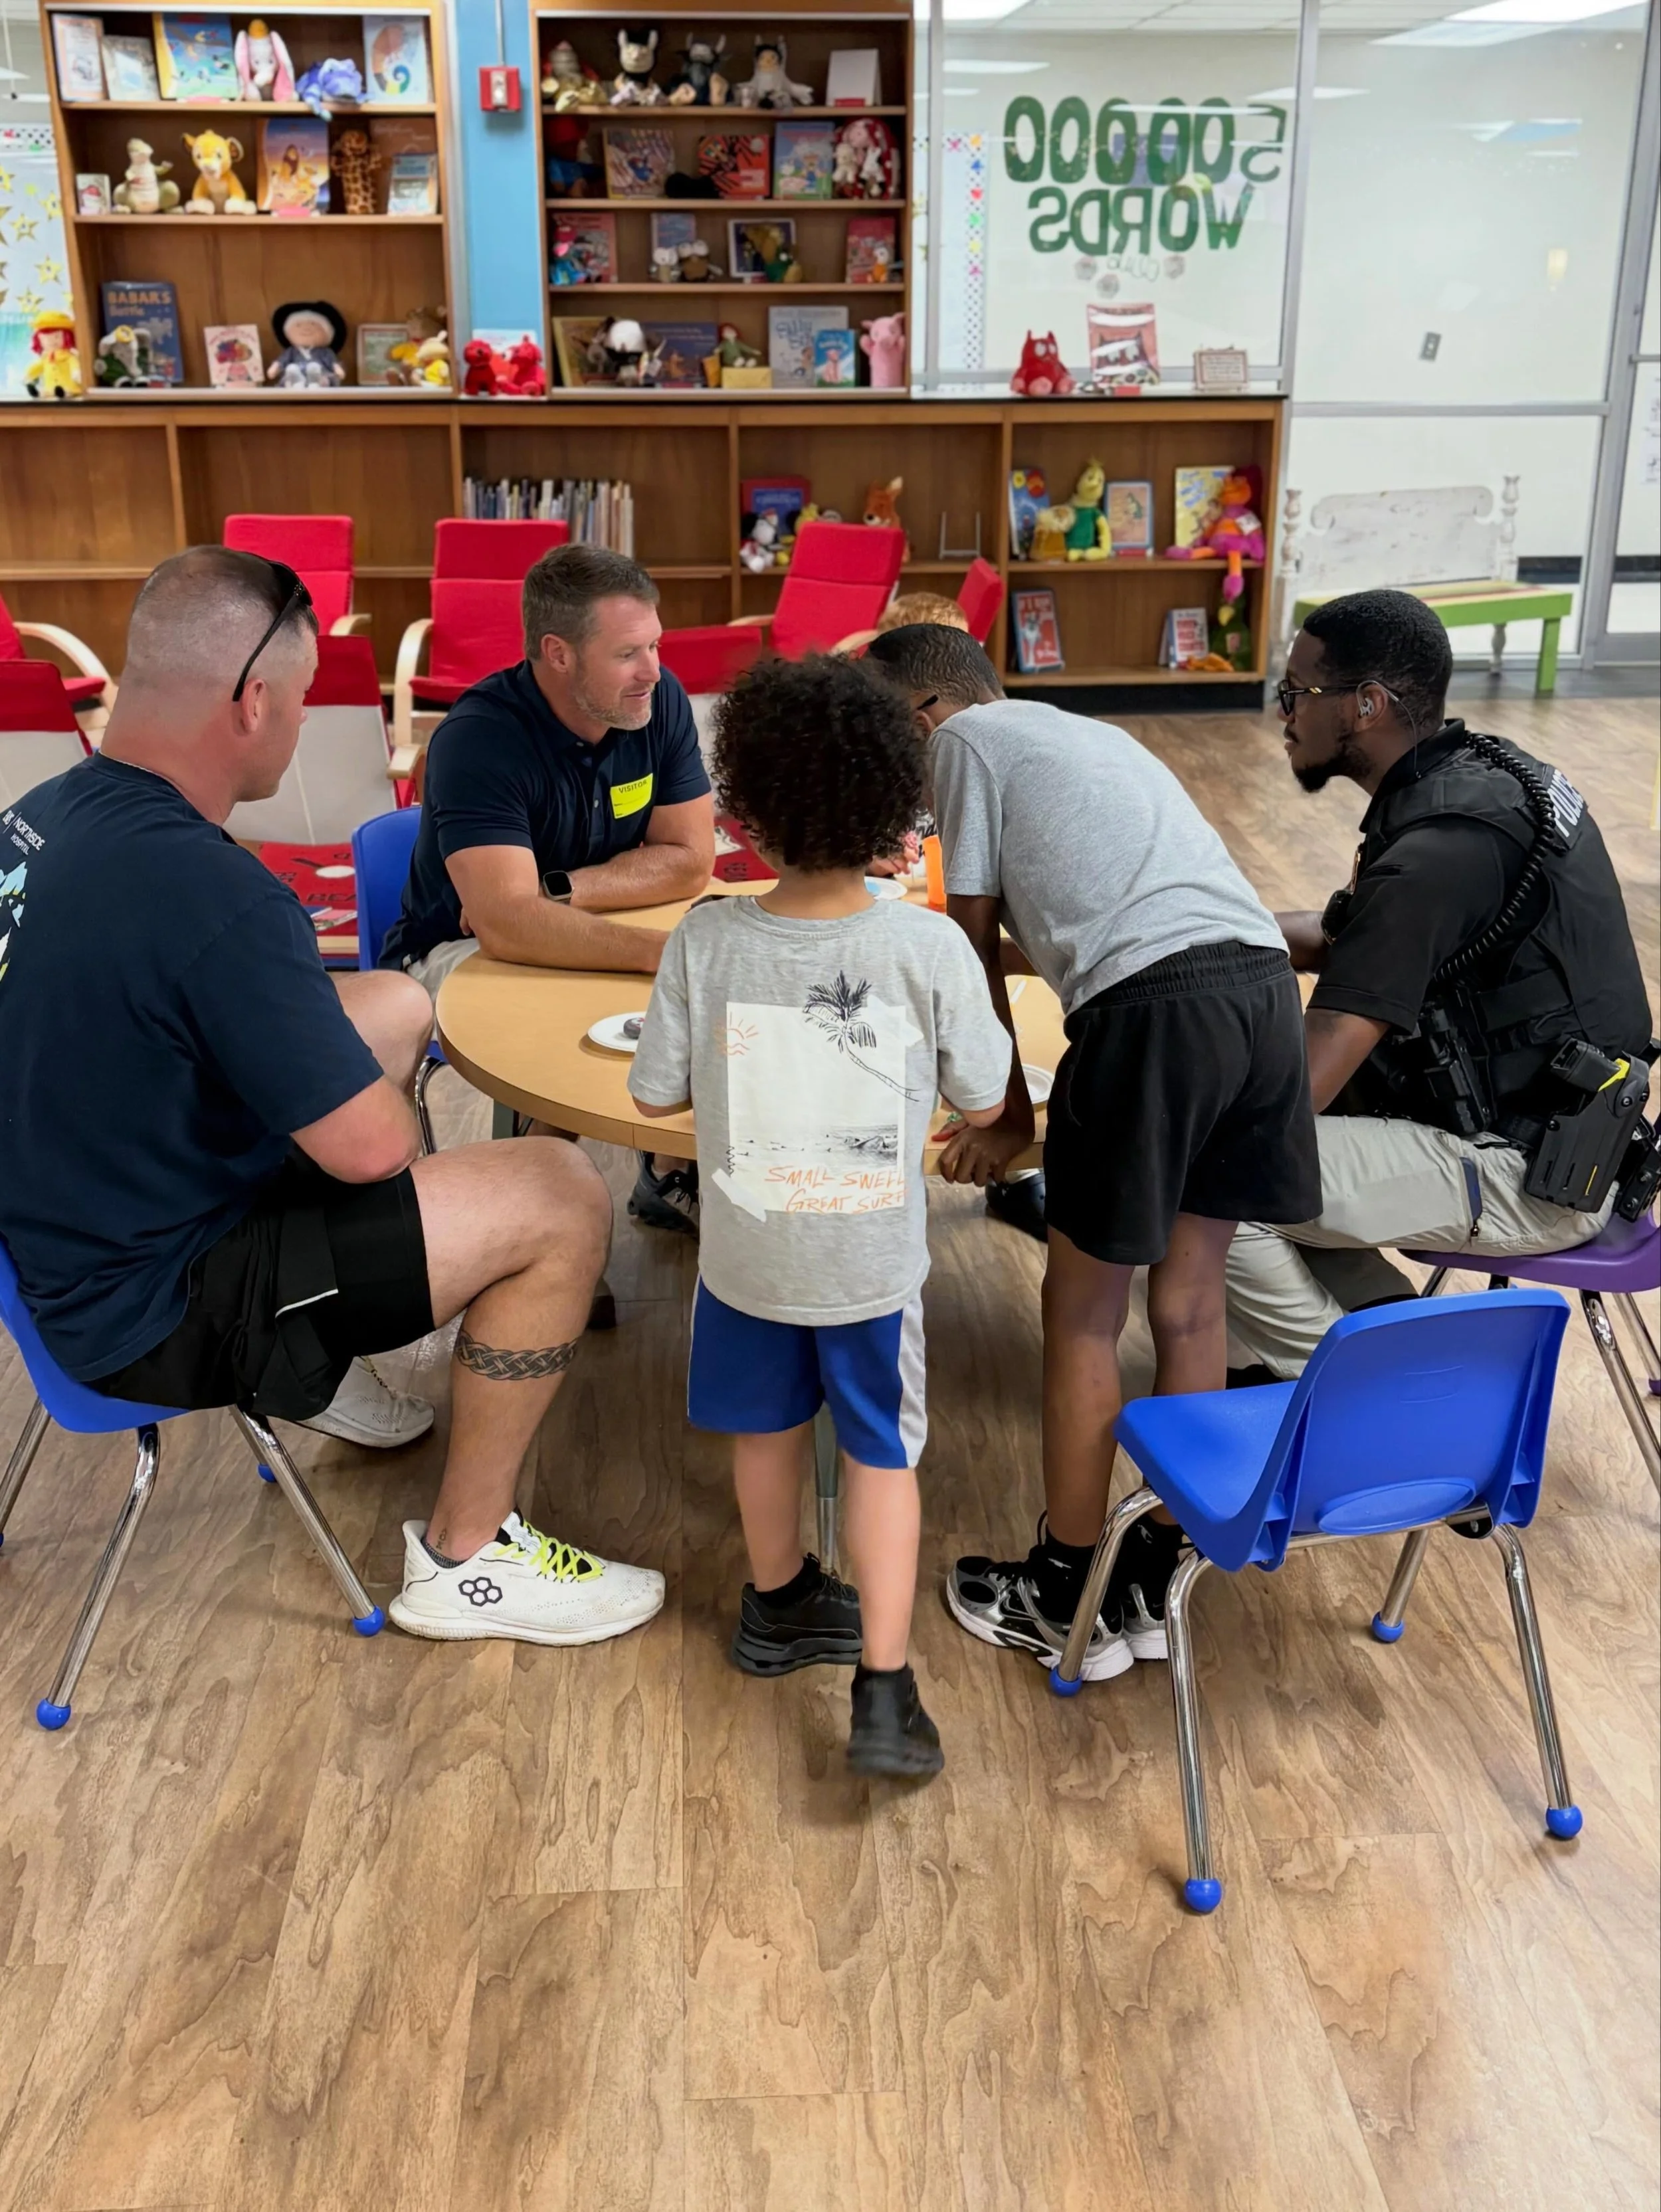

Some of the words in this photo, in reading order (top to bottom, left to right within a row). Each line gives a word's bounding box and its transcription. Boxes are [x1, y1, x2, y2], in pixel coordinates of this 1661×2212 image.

[619, 780, 647, 794] VISITOR
[13, 817, 45, 851] NORTHSIDE
[764, 1165, 835, 1188] SMALL
[840, 1169, 906, 1189] SWELL
[785, 1188, 853, 1214] GREAT
[852, 1188, 909, 1214] SURF
